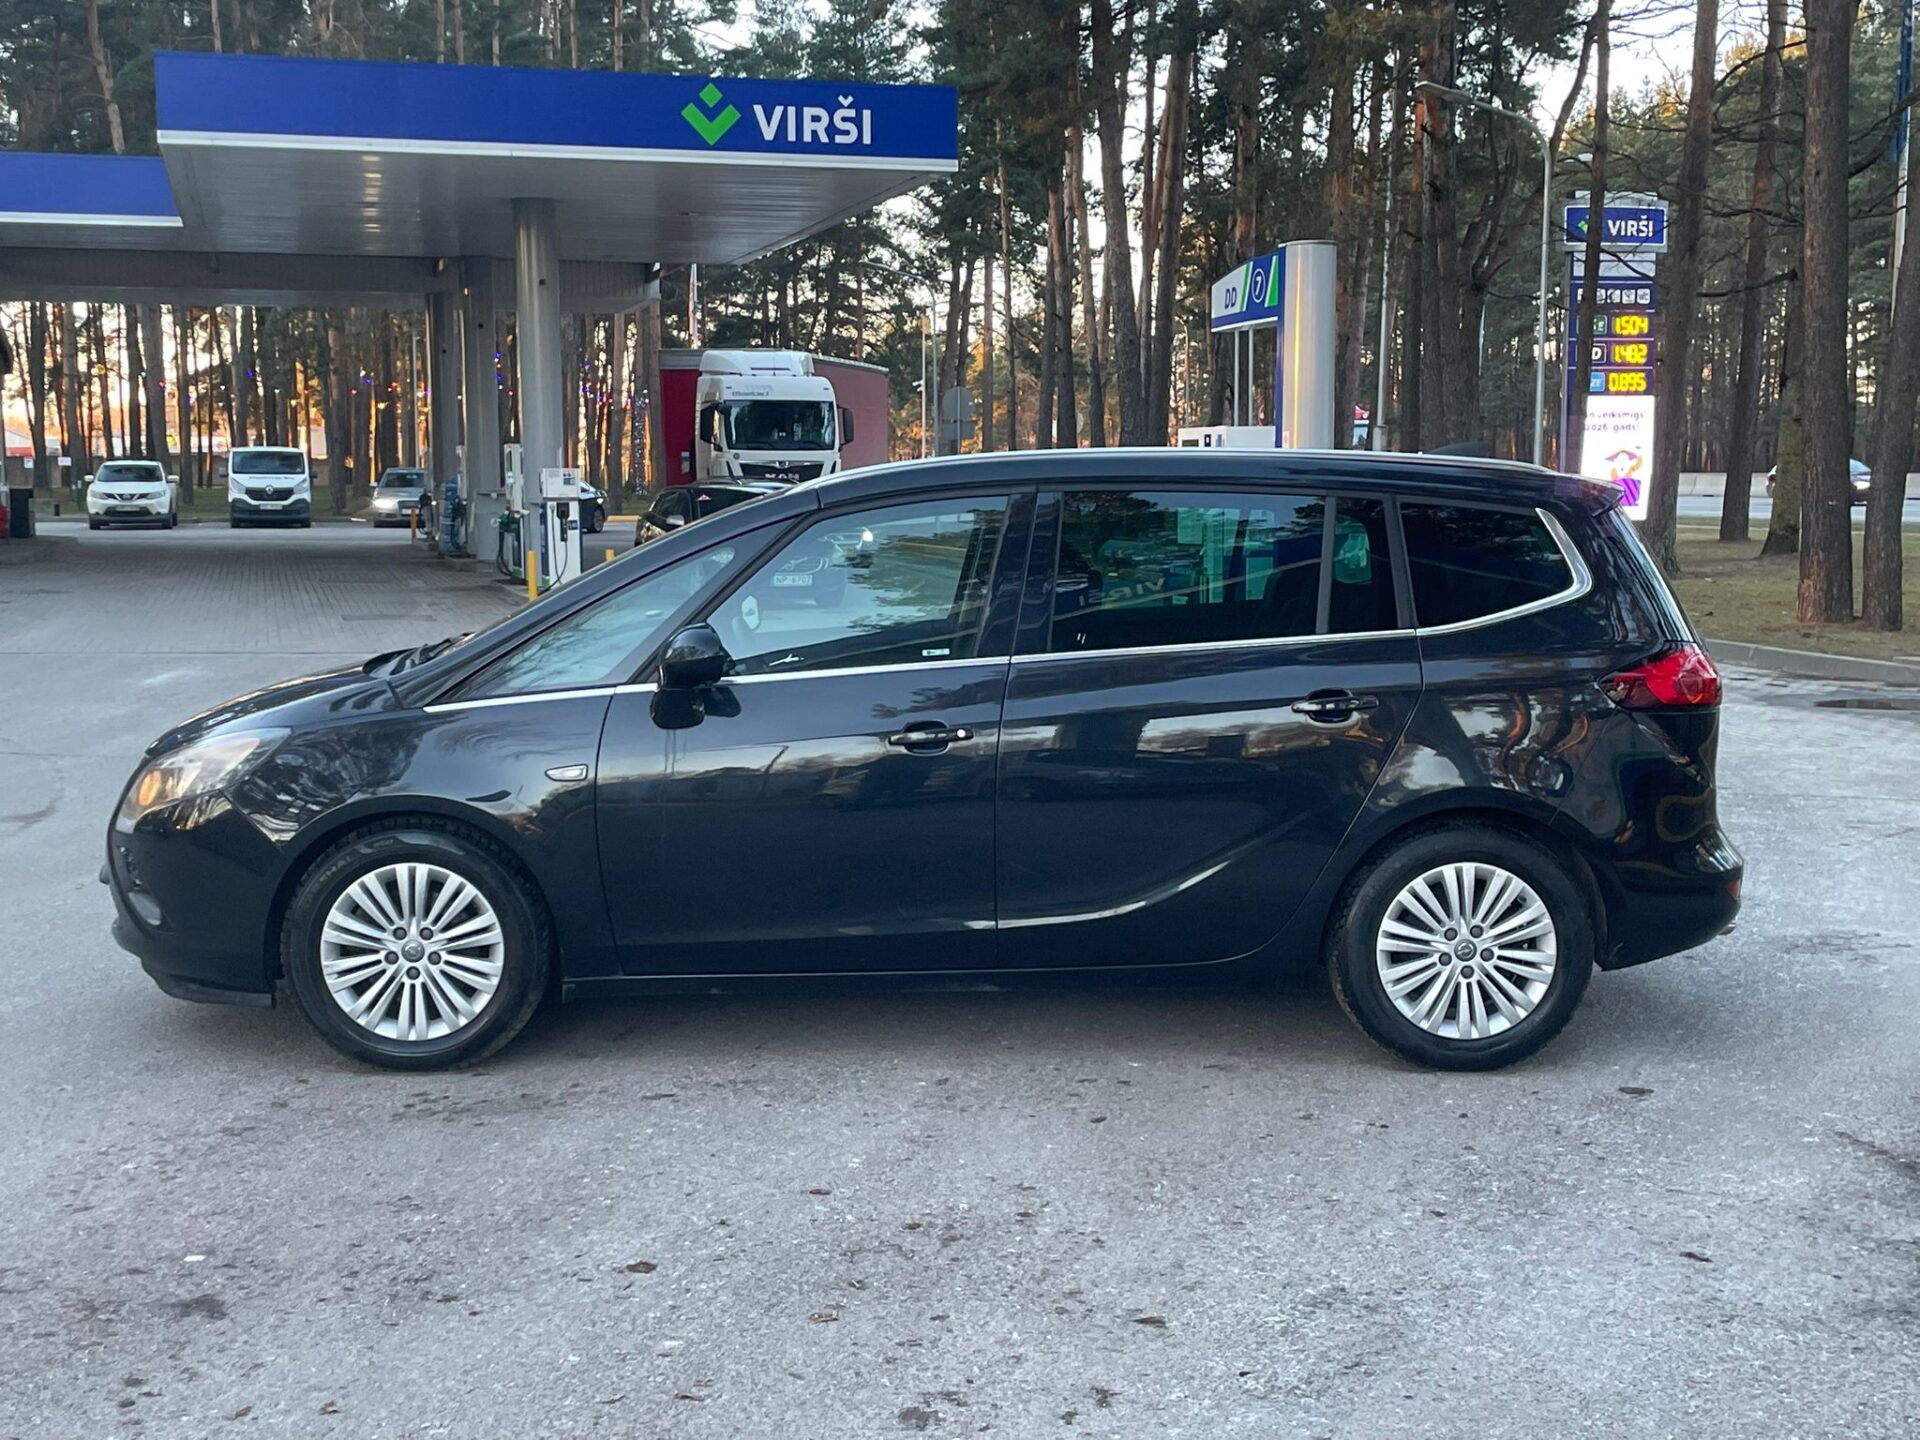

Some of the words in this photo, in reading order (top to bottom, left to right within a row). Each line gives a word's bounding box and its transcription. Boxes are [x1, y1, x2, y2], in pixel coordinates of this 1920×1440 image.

[753, 95, 872, 145] VIRŠI
[1608, 215, 1654, 237] VIRŠI
[1224, 287, 1237, 309] DD
[1255, 276, 1262, 294] 7
[765, 473, 800, 481] MAN
